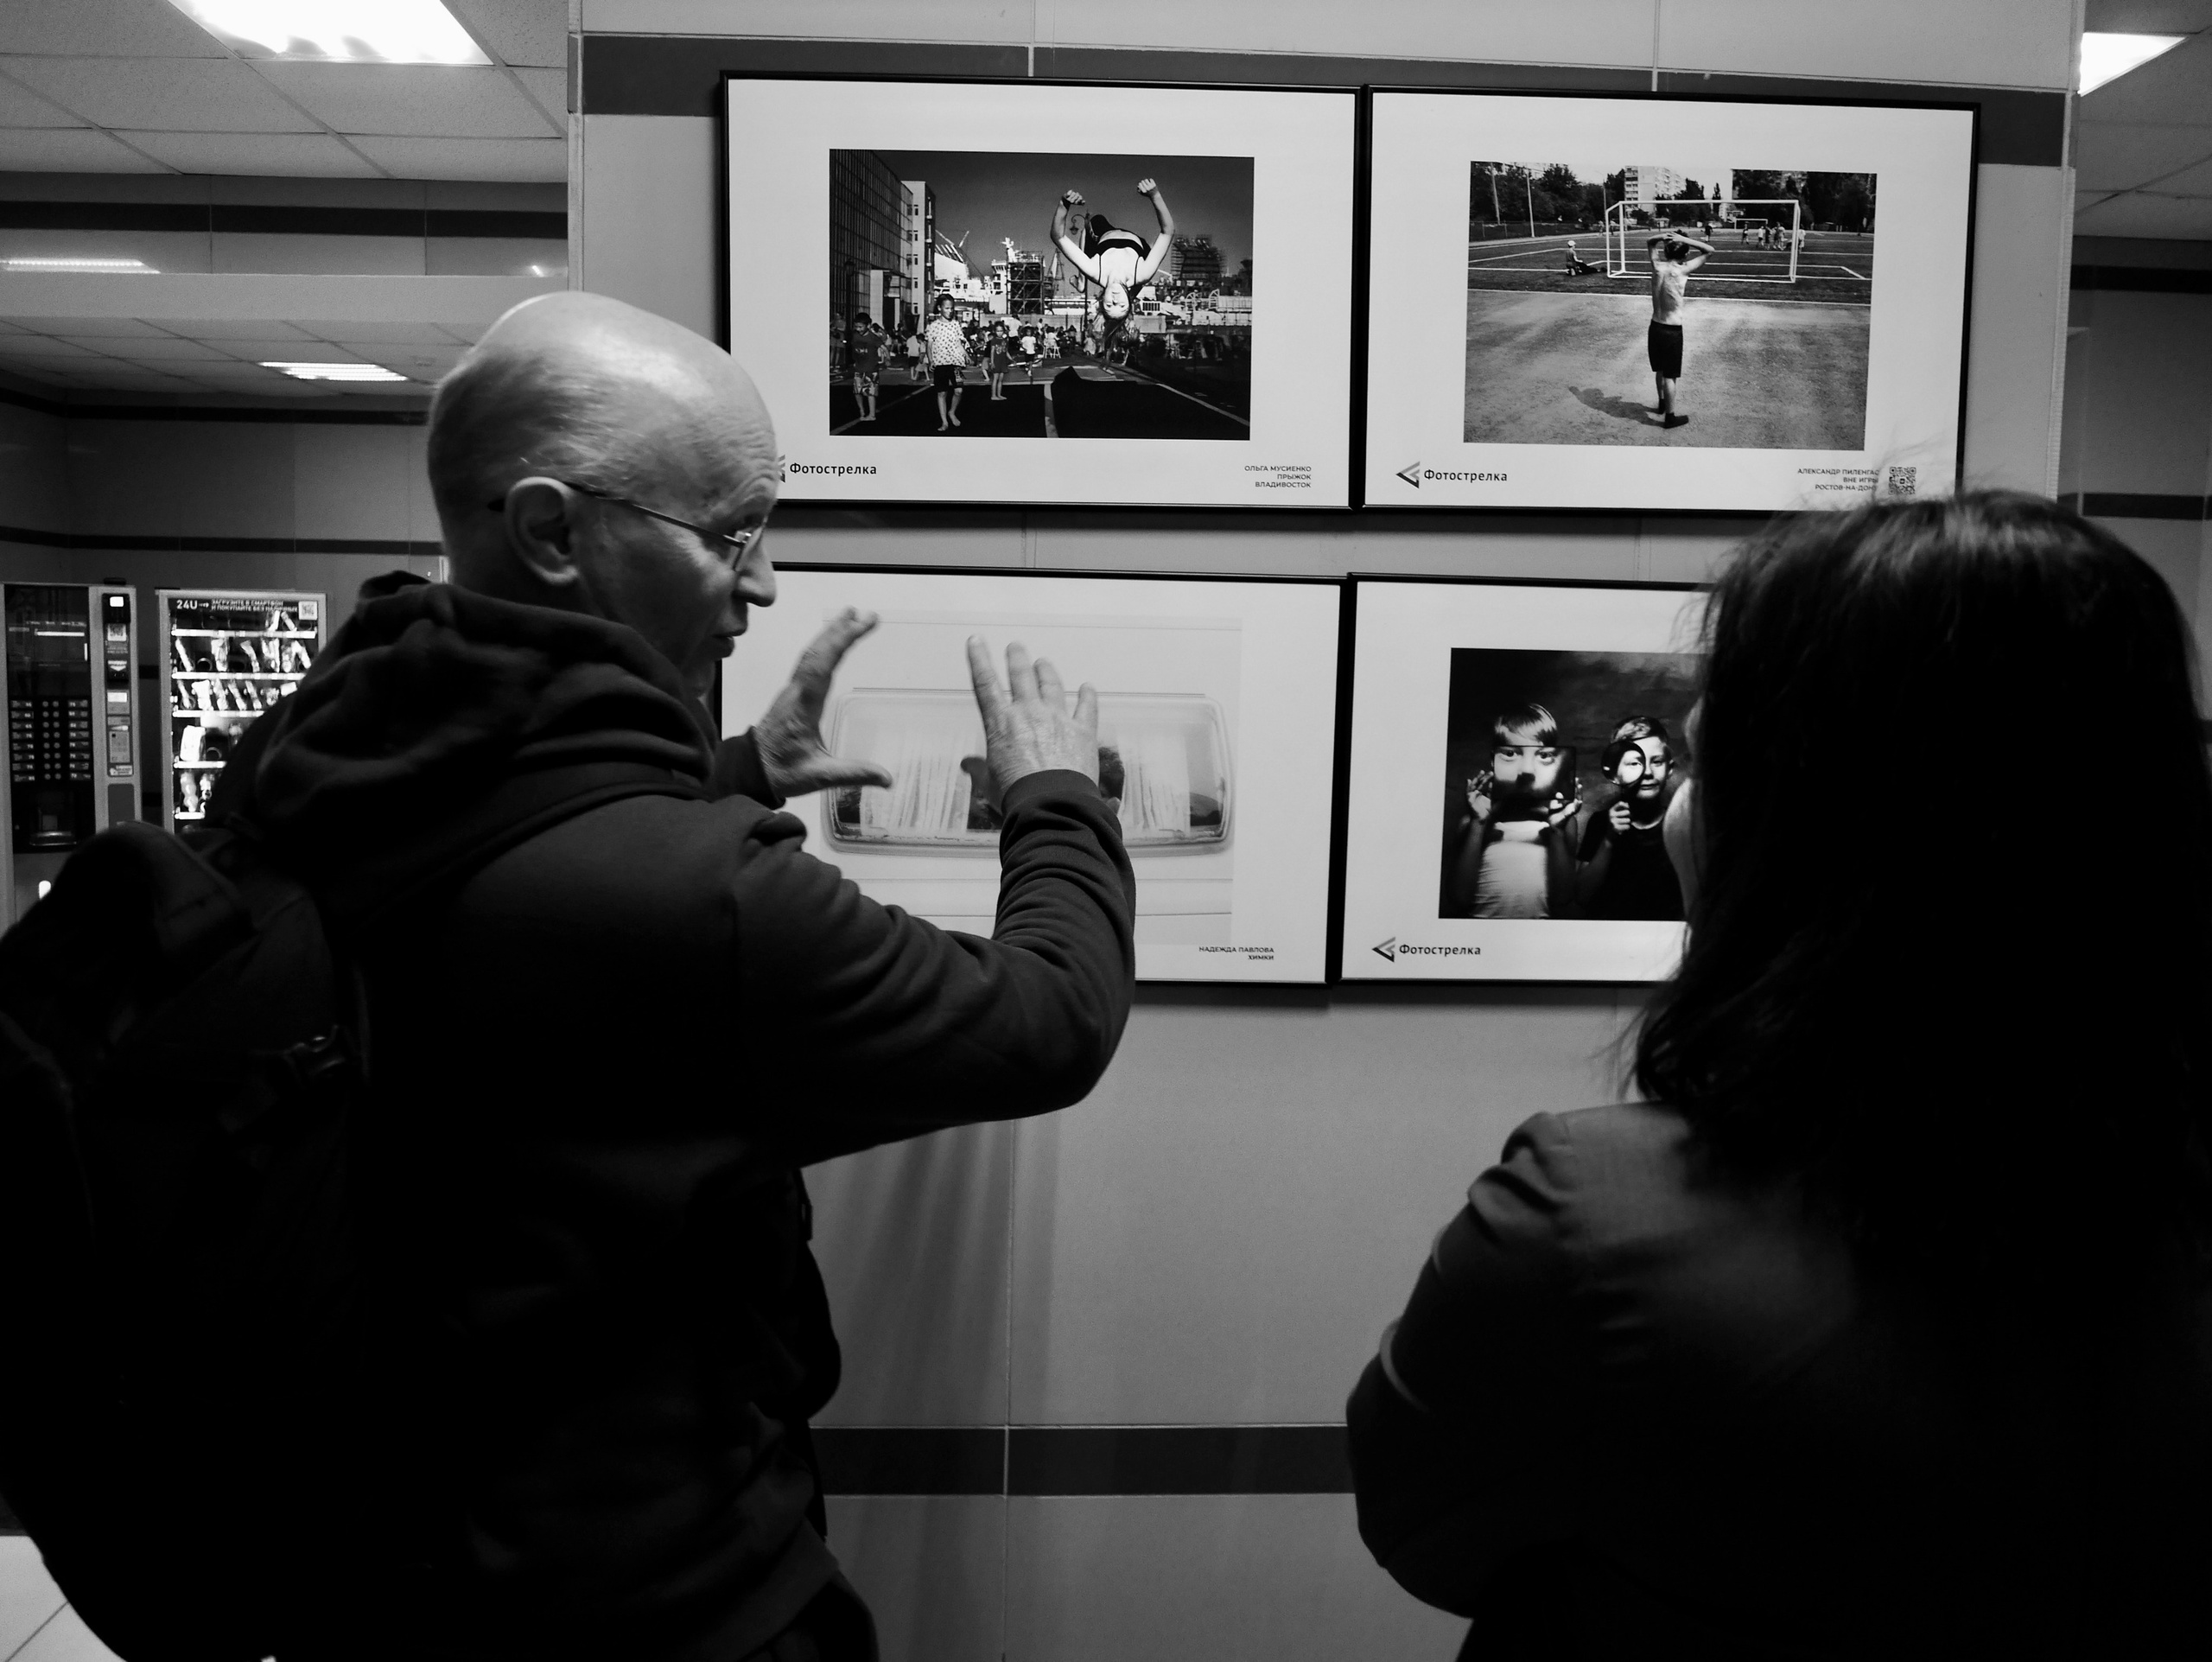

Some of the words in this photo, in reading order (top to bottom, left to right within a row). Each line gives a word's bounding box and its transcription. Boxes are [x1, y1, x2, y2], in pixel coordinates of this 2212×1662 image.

[790, 462, 877, 477] Фотострелка
[1424, 469, 1507, 483] Фотострелка
[176, 599, 198, 609] 24U
[1399, 944, 1481, 957] Фотострелка
